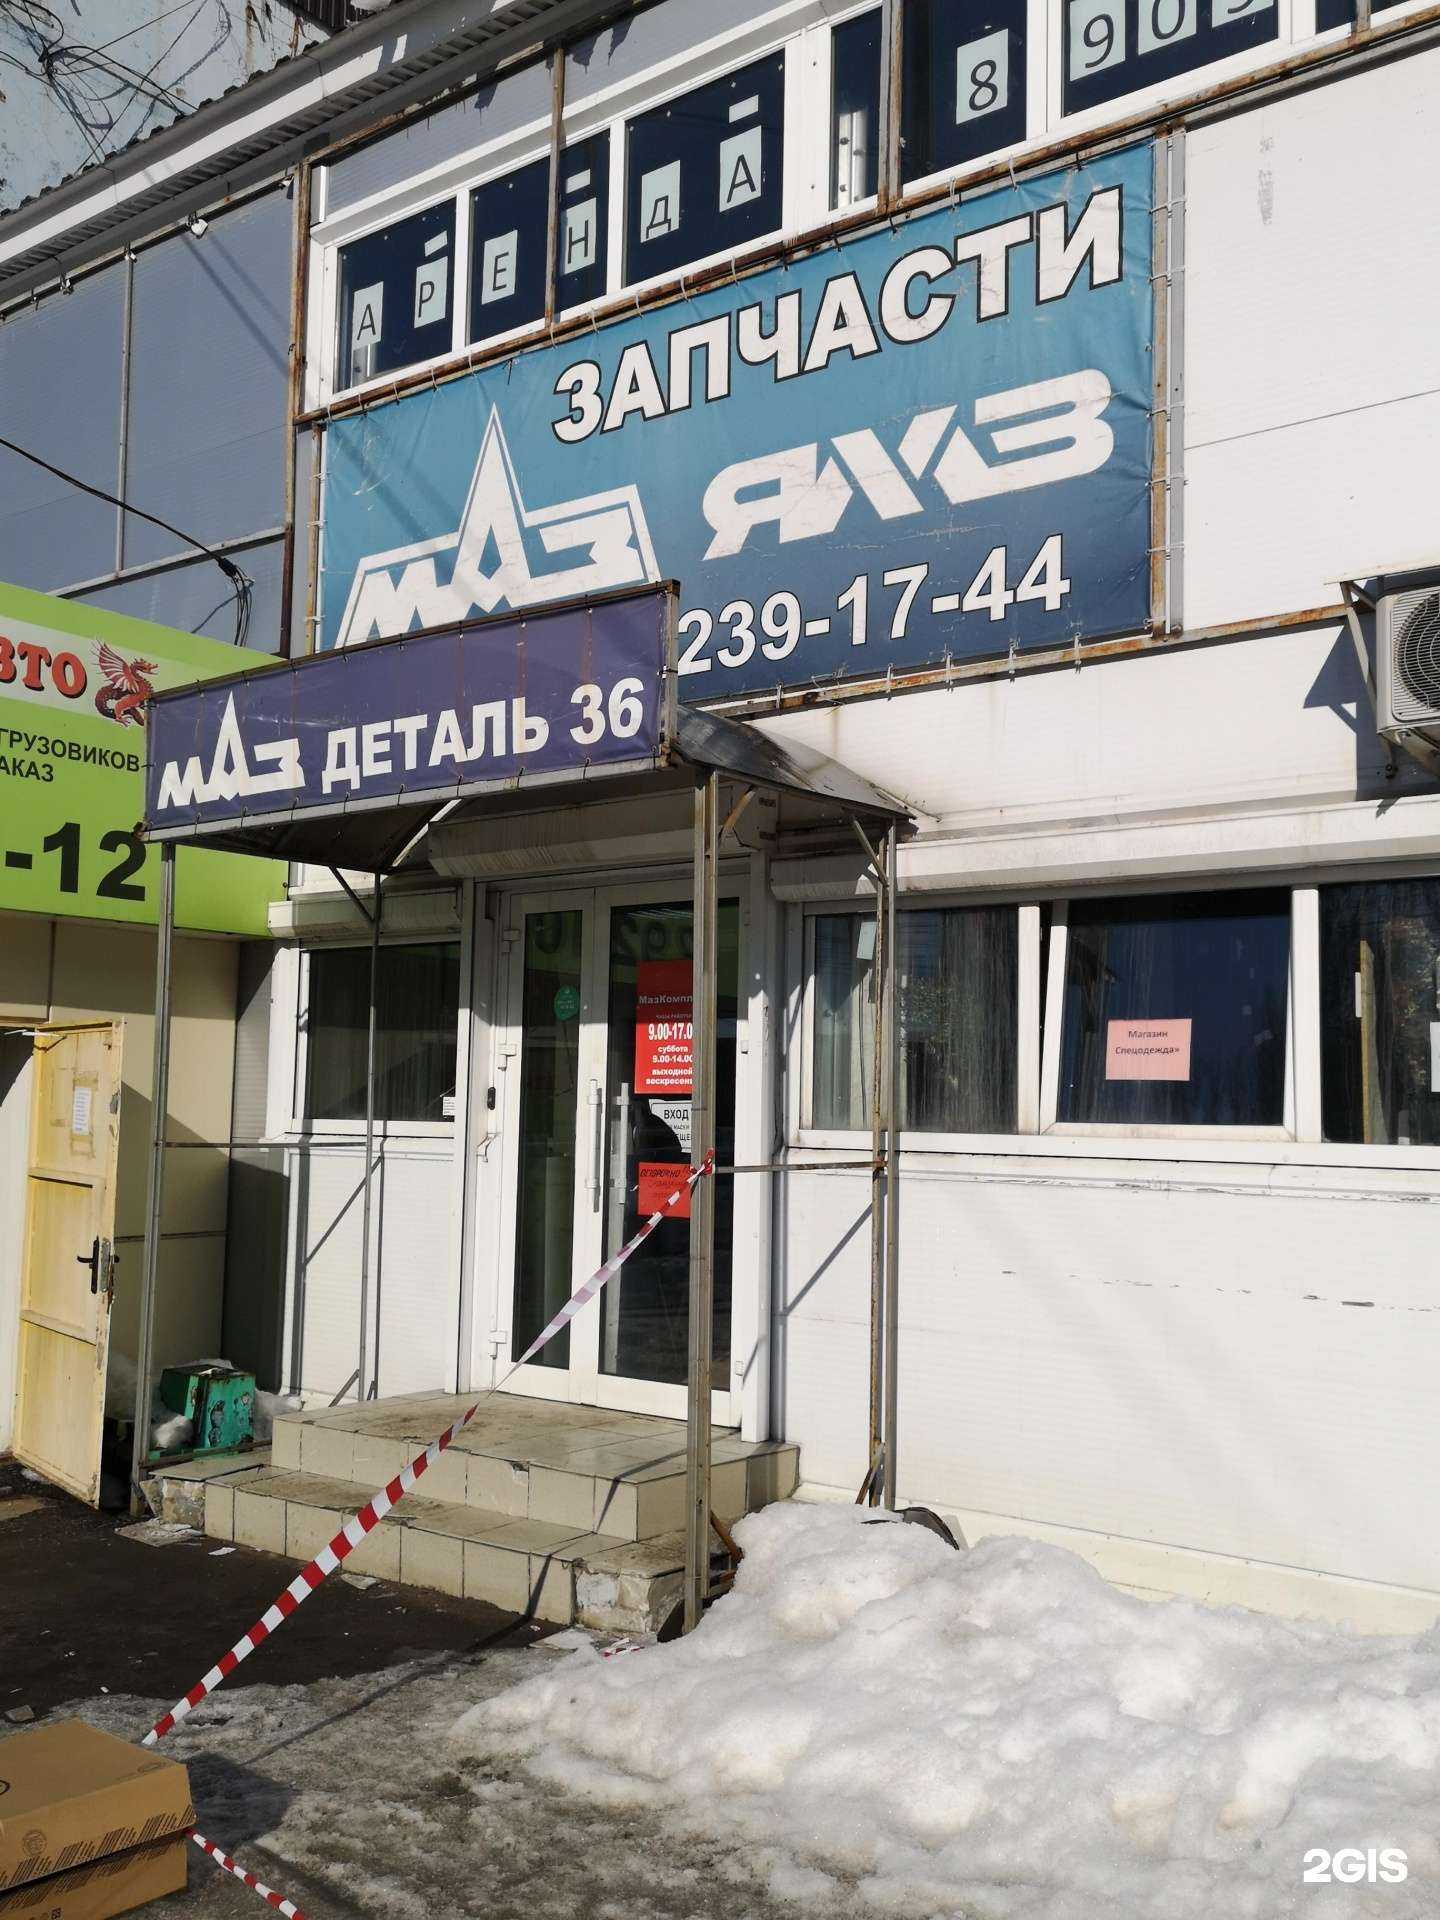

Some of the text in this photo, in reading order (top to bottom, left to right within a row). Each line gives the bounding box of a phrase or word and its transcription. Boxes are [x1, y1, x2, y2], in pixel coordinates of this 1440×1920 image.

[969, 60, 999, 111] 8
[551, 184, 1124, 445] ЗАПЧАСТИ
[335, 402, 661, 648] МАЗ
[703, 368, 1114, 560] ЯМЗ
[678, 534, 1072, 675] 239-17-44
[157, 677, 645, 810] МАЗ ДЕТАЛЬ 36
[657, 1045, 688, 1054] суббота
[1128, 1030, 1168, 1038] Магазин
[663, 1109, 689, 1121] ВХОД
